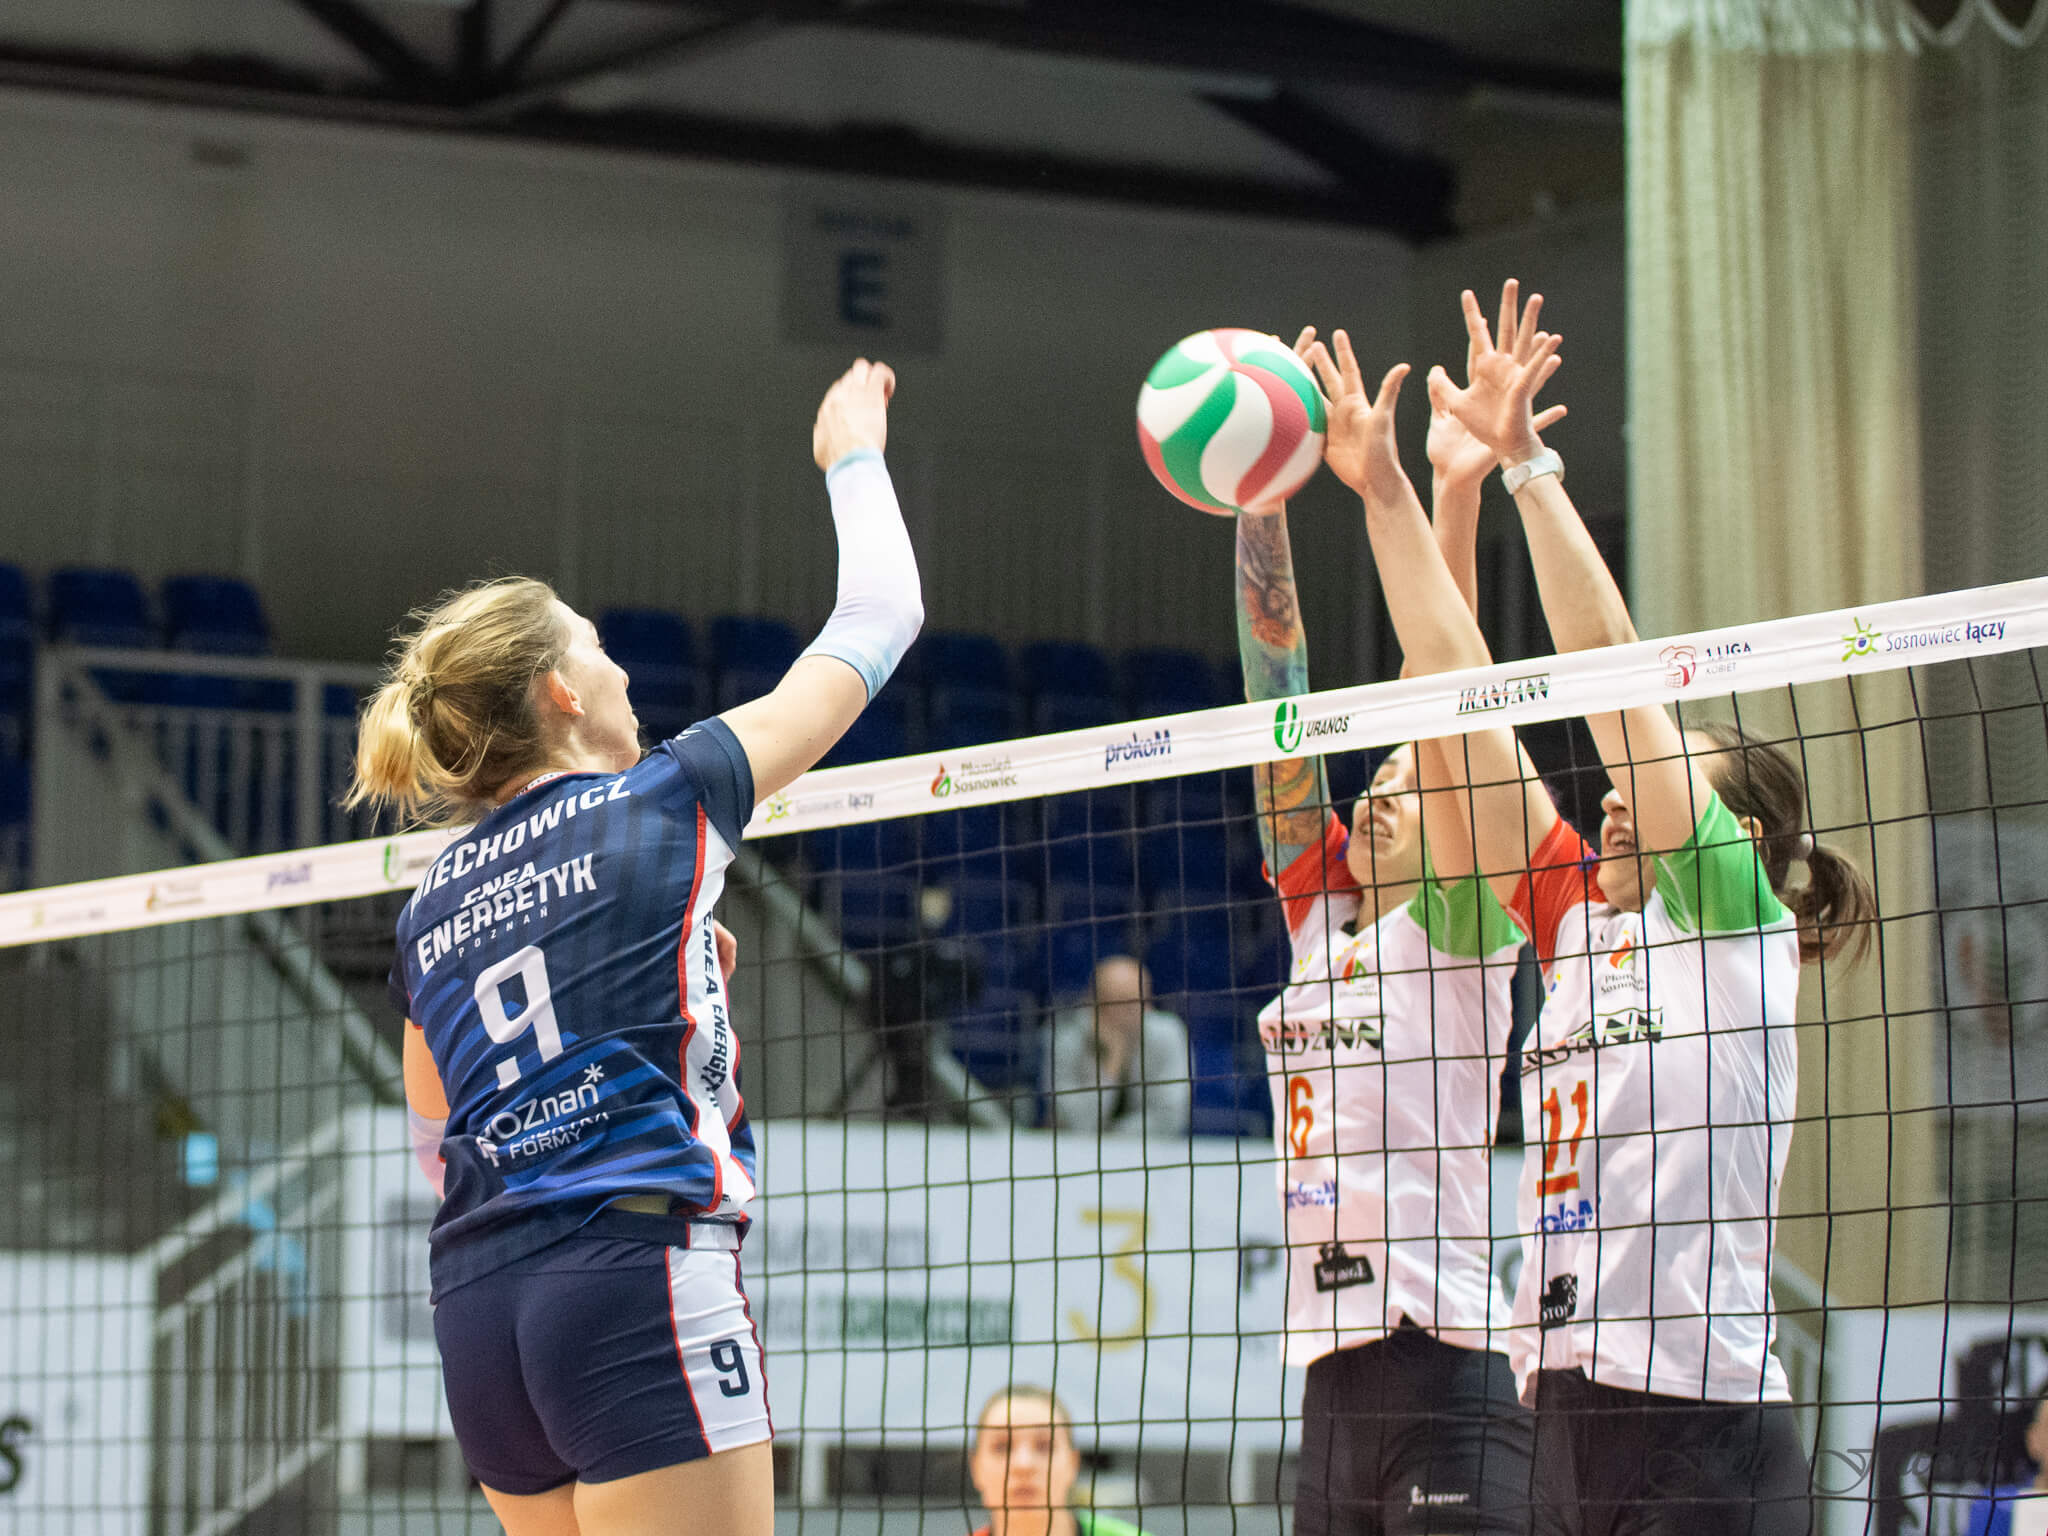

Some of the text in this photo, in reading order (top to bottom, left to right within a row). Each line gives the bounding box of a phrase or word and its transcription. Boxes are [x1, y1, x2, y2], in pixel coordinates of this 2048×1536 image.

[838, 251, 888, 329] E
[1886, 620, 2006, 652] Sosnowiec łączy
[1306, 716, 1349, 738] URANOS
[953, 775, 1018, 796] Sosnowiec
[417, 853, 598, 976] ENERGETYK
[460, 862, 537, 909] ENEA
[703, 911, 720, 995] ENEA
[474, 945, 564, 1090] 9
[509, 1128, 582, 1159] FORMY
[1289, 1075, 1314, 1158] 6
[1543, 1080, 1588, 1174] 11
[1068, 1208, 1155, 1351] 3
[710, 1339, 750, 1397] 9
